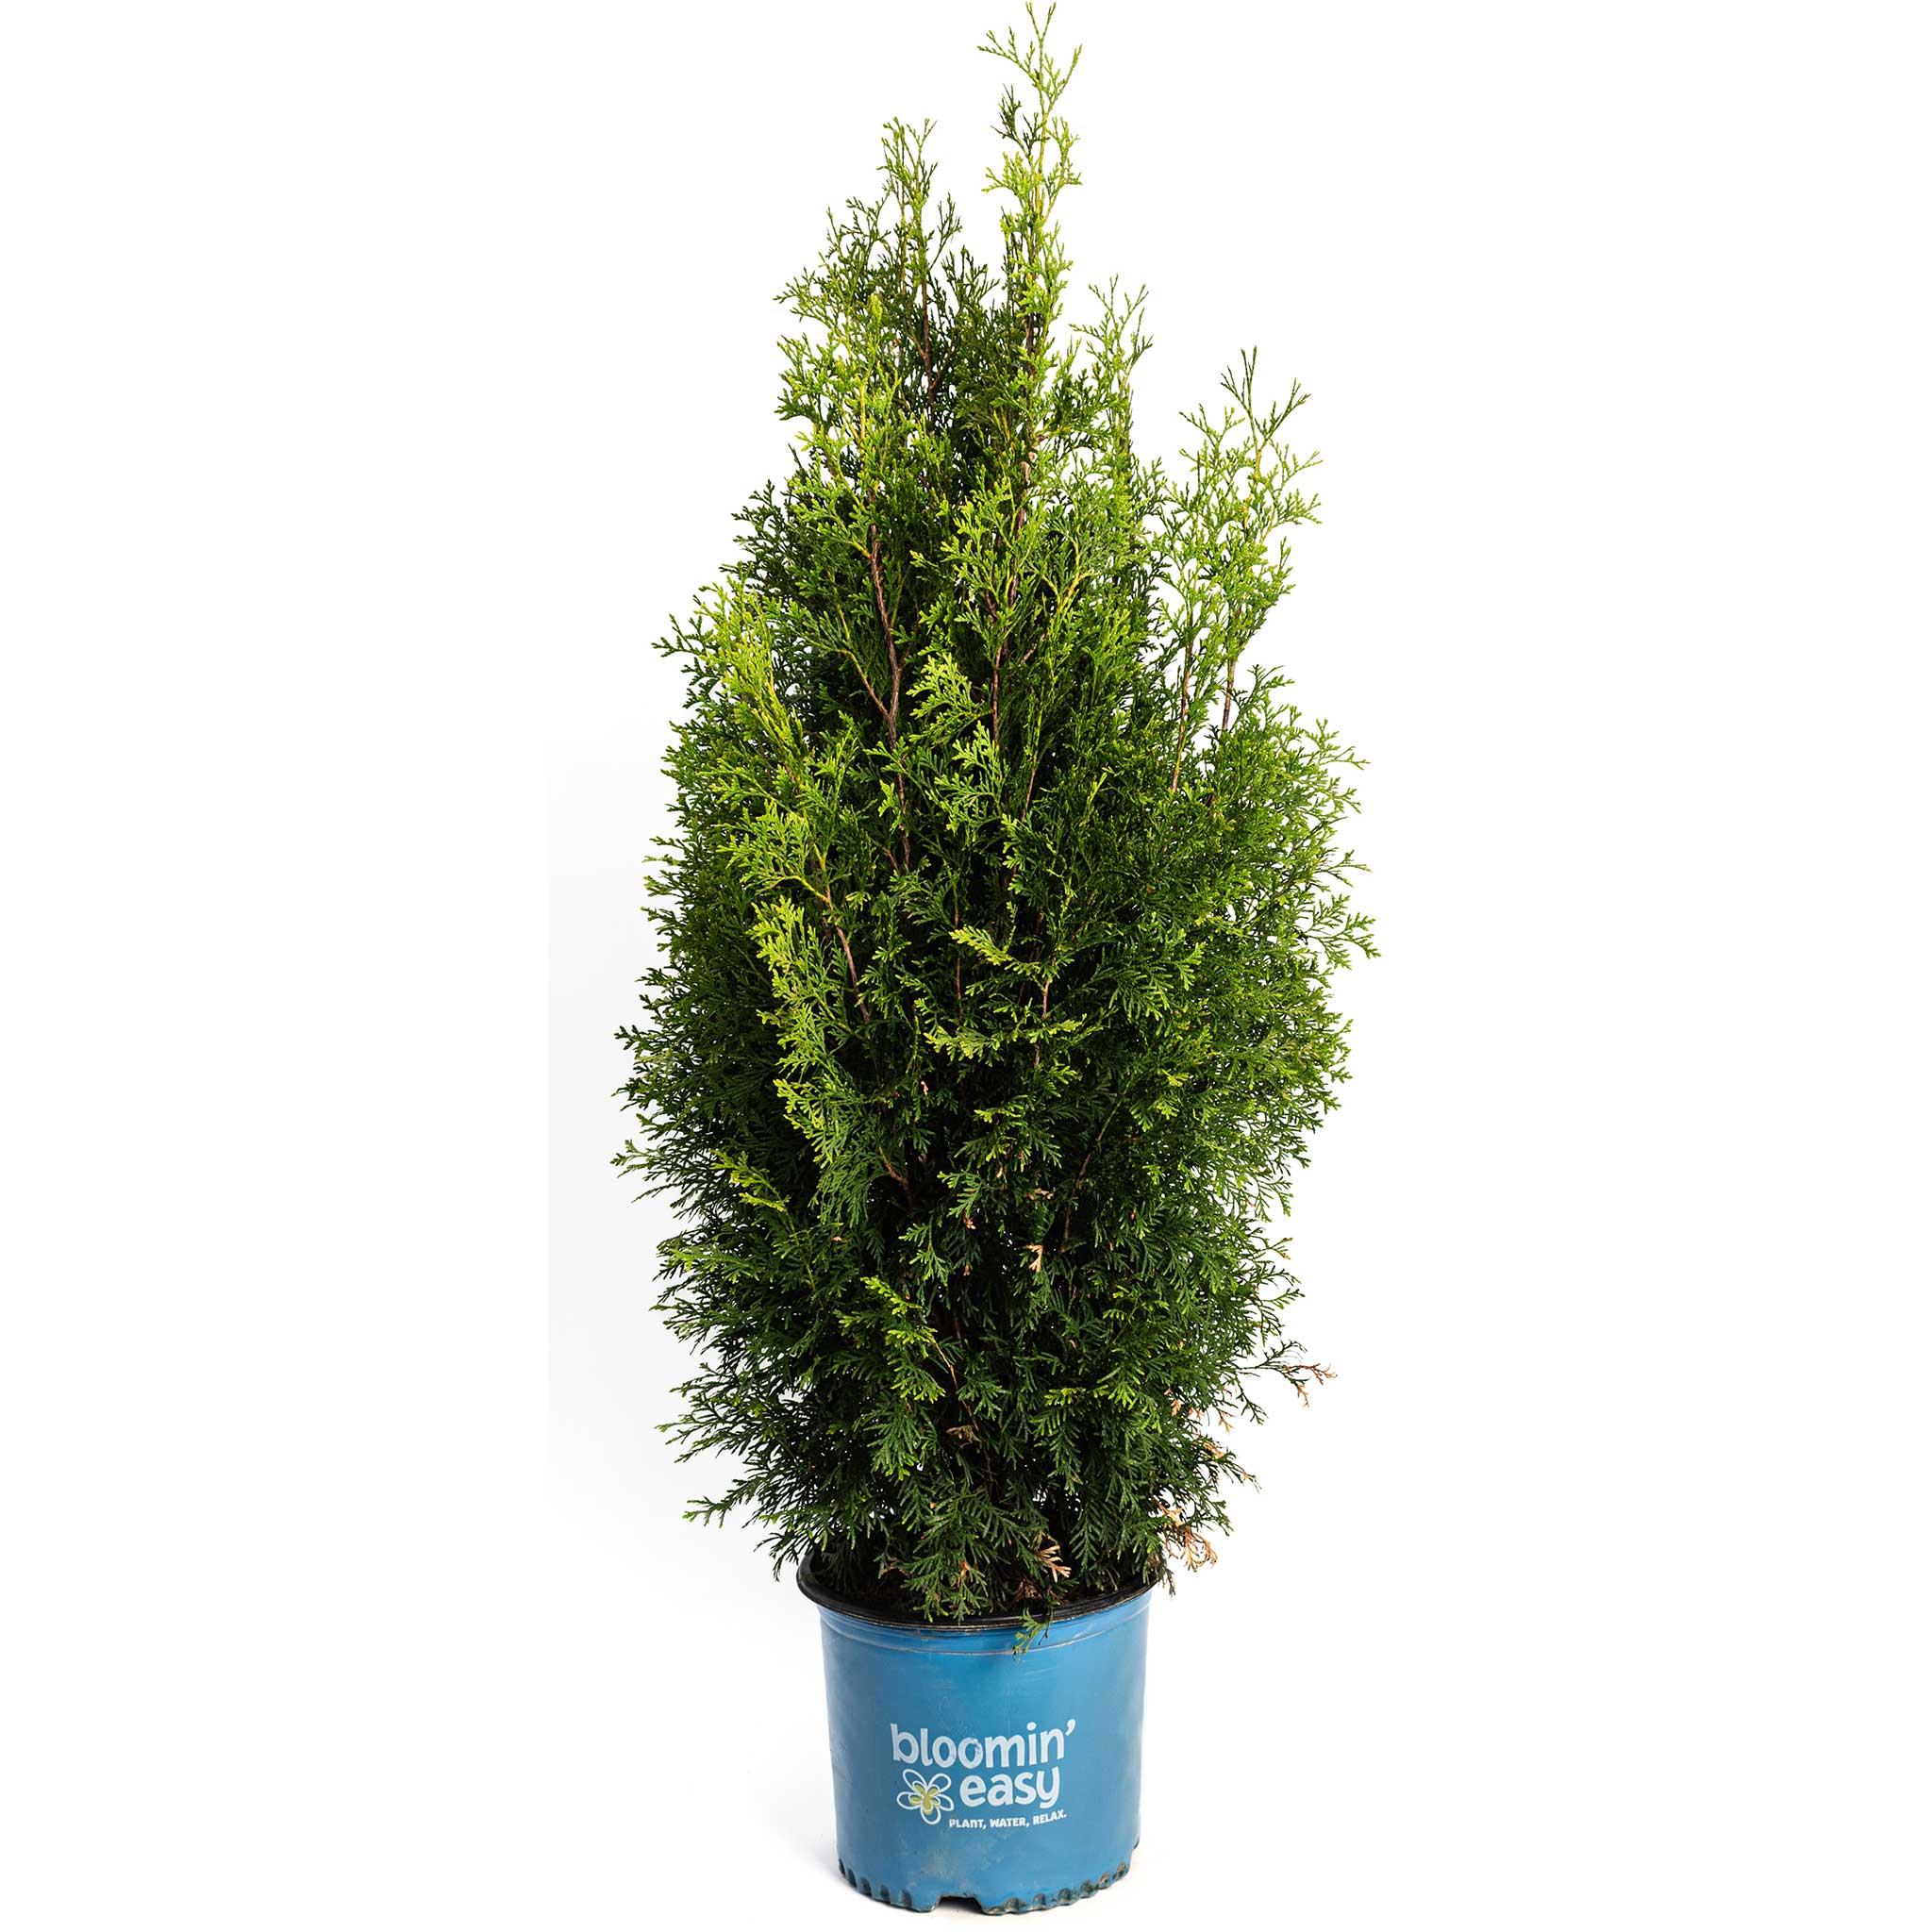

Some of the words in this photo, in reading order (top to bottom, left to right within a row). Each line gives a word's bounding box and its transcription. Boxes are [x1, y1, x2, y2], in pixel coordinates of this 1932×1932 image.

[890, 1719, 1076, 1770] bloomin'
[959, 1766, 1060, 1809] easy
[948, 1817, 987, 1830] PLANT,
[990, 1815, 1030, 1828] WATER,
[1033, 1809, 1068, 1826] RELAX.
